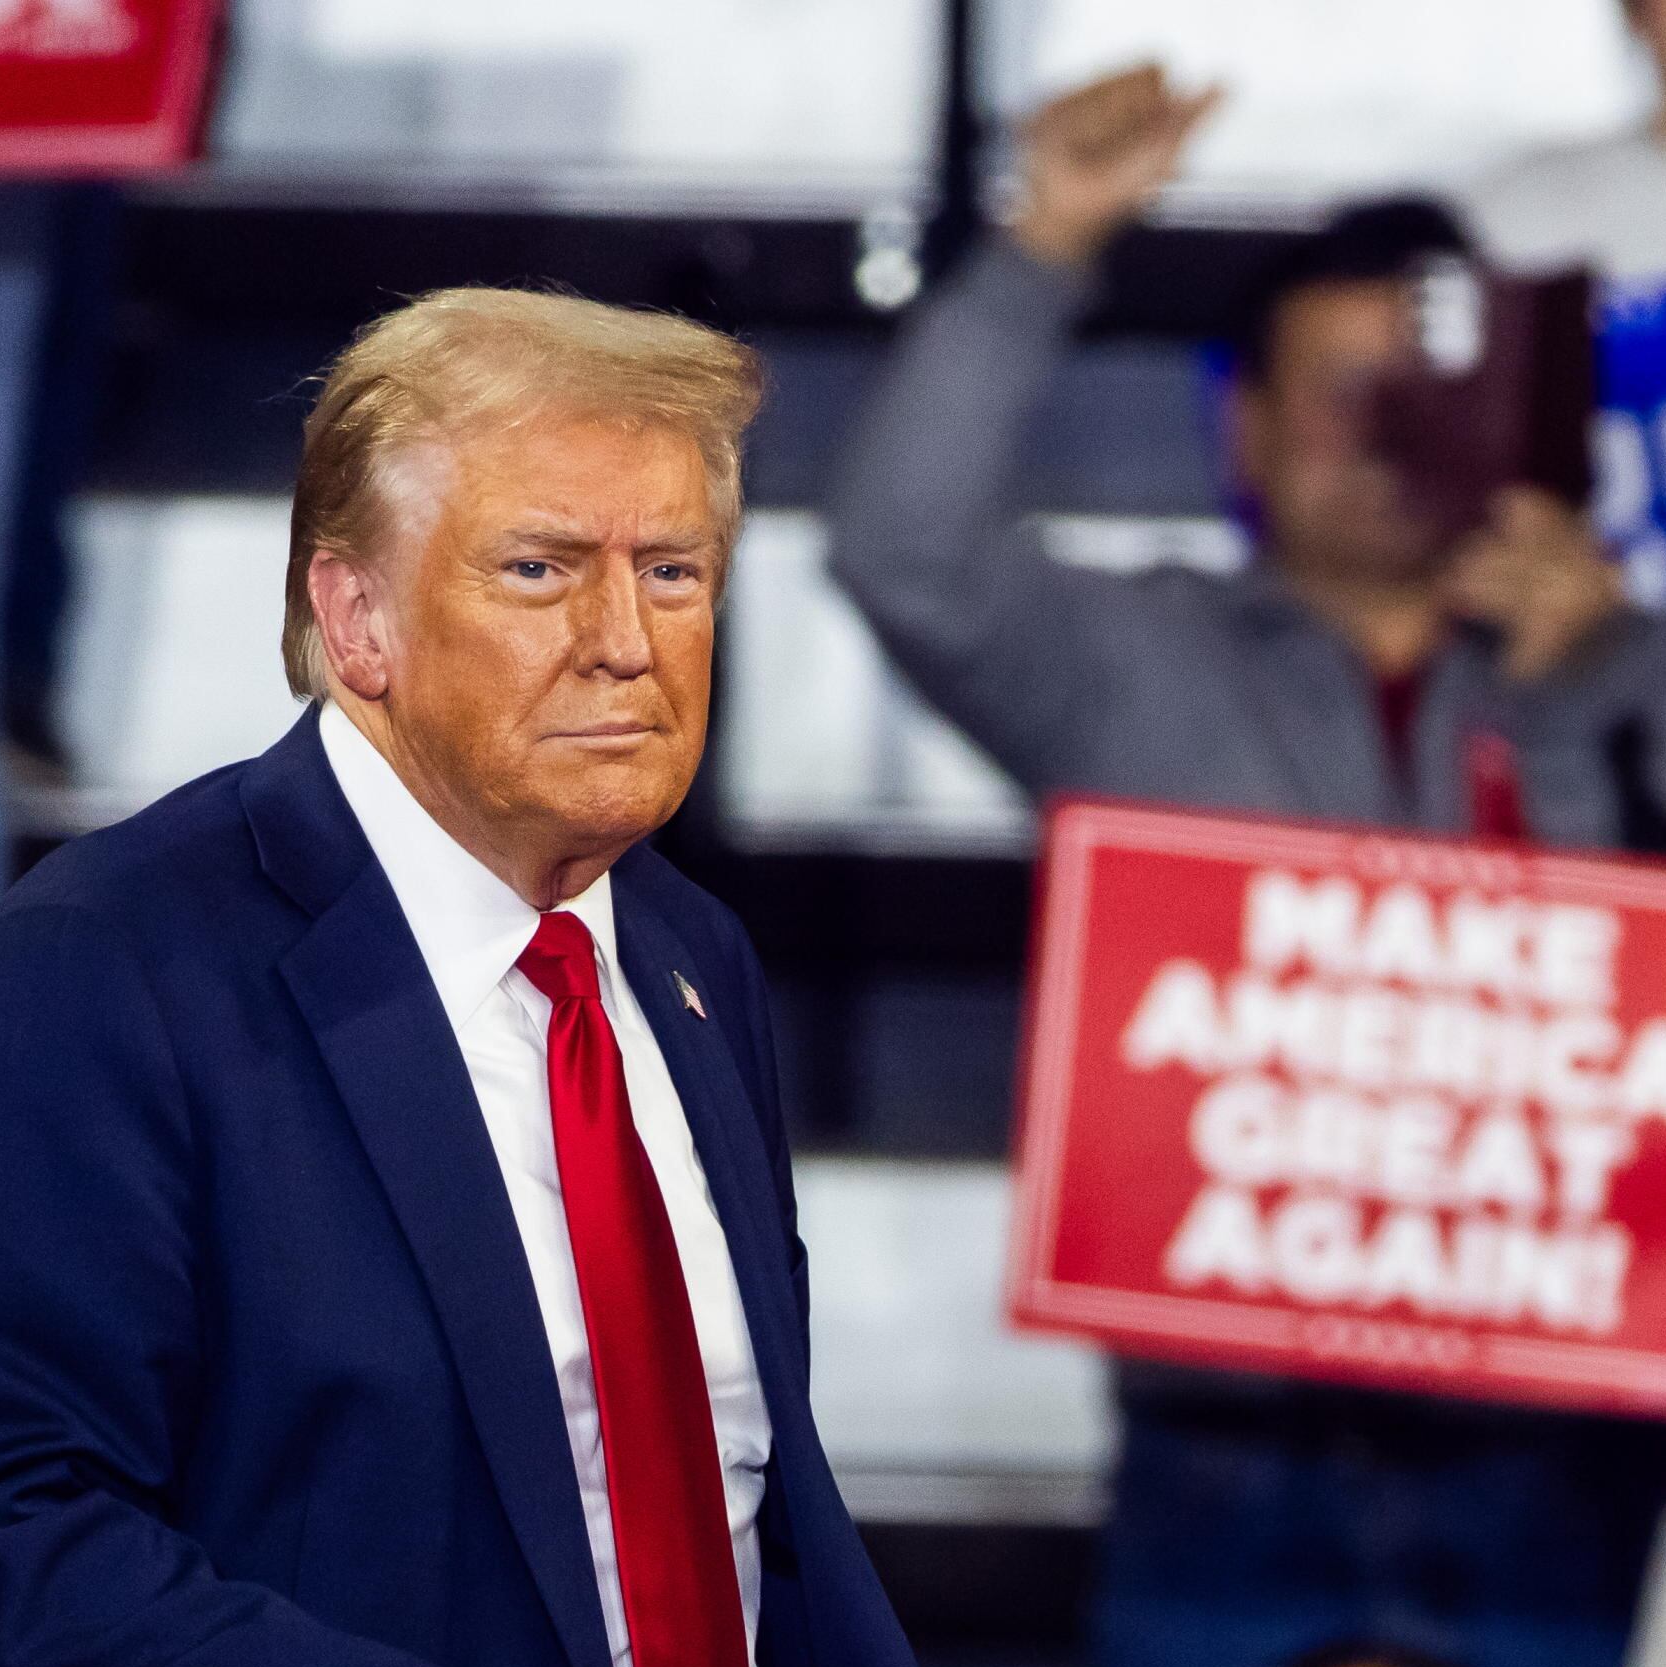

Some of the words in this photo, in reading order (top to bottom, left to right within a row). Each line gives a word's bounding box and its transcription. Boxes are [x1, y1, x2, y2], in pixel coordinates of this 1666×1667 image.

[1244, 868, 1624, 1008] MAKE
[1190, 1070, 1637, 1220] GREAT
[1162, 1183, 1633, 1337] AGAIN!
